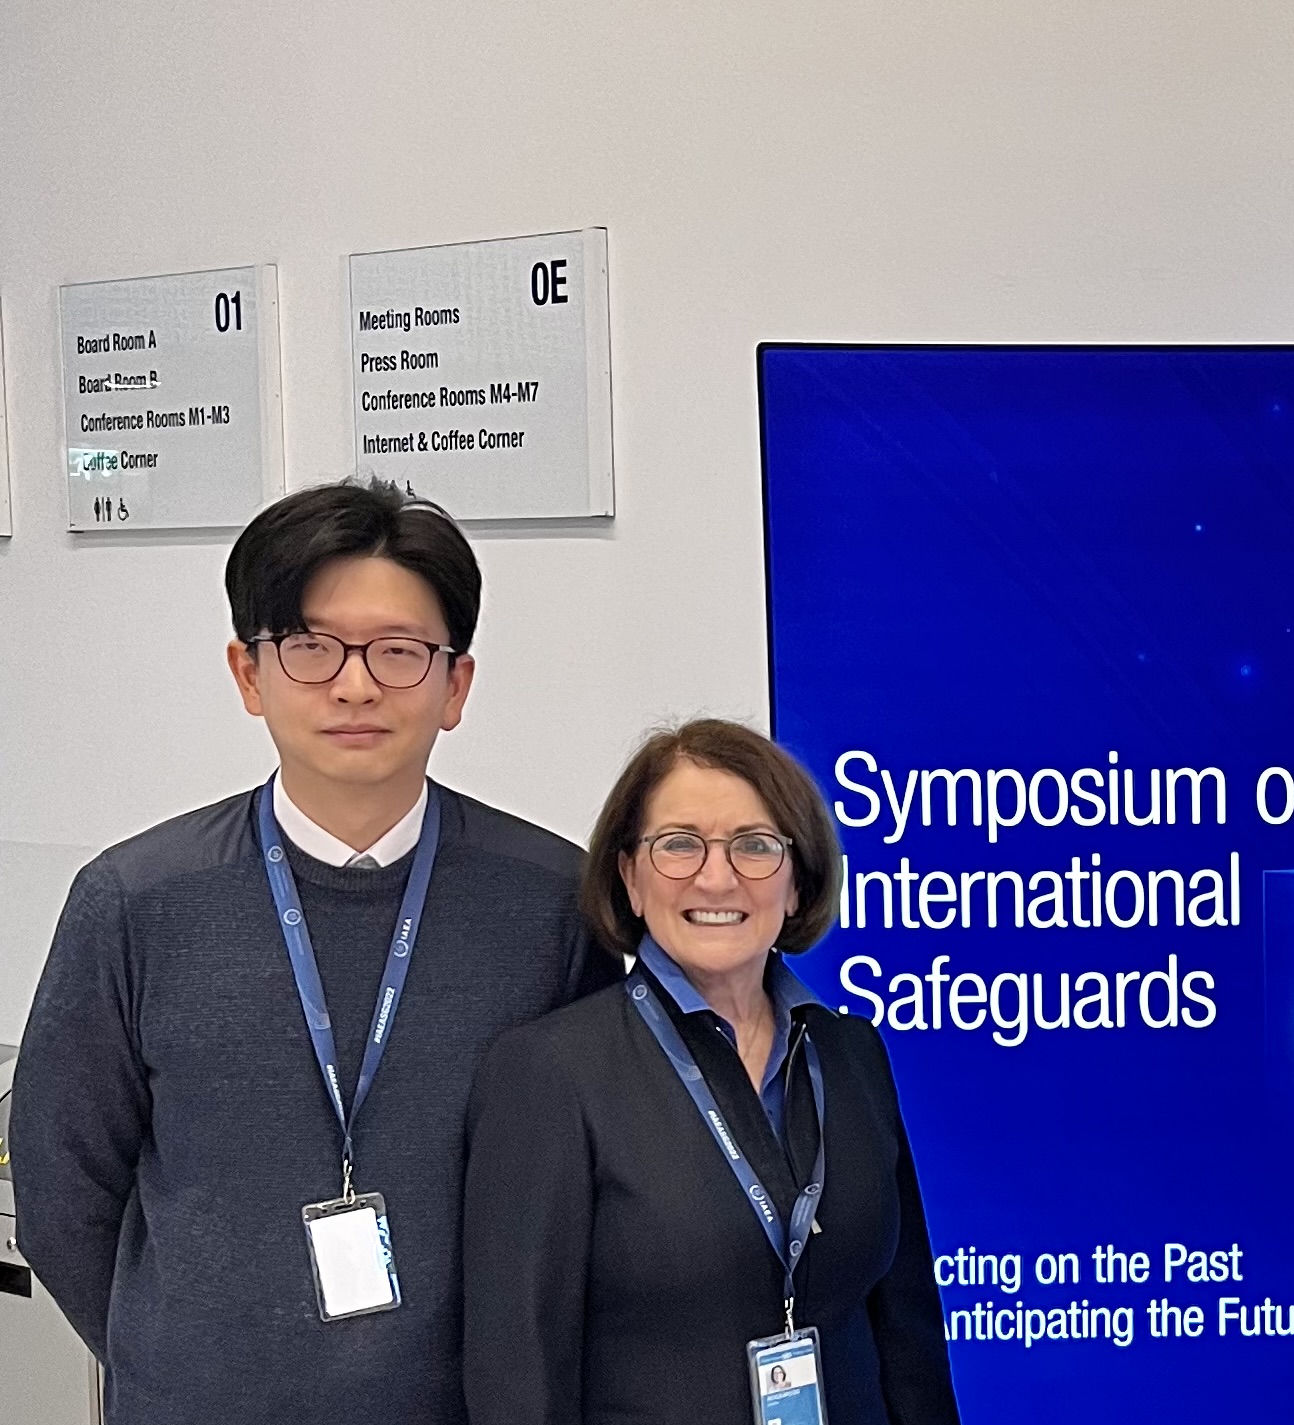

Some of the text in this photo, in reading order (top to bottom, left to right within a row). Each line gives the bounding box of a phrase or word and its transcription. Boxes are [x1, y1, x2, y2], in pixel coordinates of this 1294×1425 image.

[531, 259, 568, 306] 0E
[215, 291, 242, 332] 01
[359, 307, 460, 332] Meeting Rooms
[77, 330, 157, 354] Board Room A
[361, 350, 439, 373] Press Room
[79, 373, 112, 394] Board
[114, 373, 147, 391] Room
[362, 382, 539, 411] Conference Rooms M4-M7
[81, 405, 230, 432] Conference Rooms M1-M3
[363, 428, 525, 454] Internet & Coffee Corner
[82, 451, 159, 471] Coffee Corner
[834, 750, 1226, 844] Symposium
[839, 851, 1240, 929] International
[839, 953, 1217, 1047] Safeguards
[1035, 1253, 1079, 1285] on
[1092, 1244, 1150, 1284] the
[1164, 1242, 1243, 1283] Past
[1147, 1299, 1204, 1337] the
